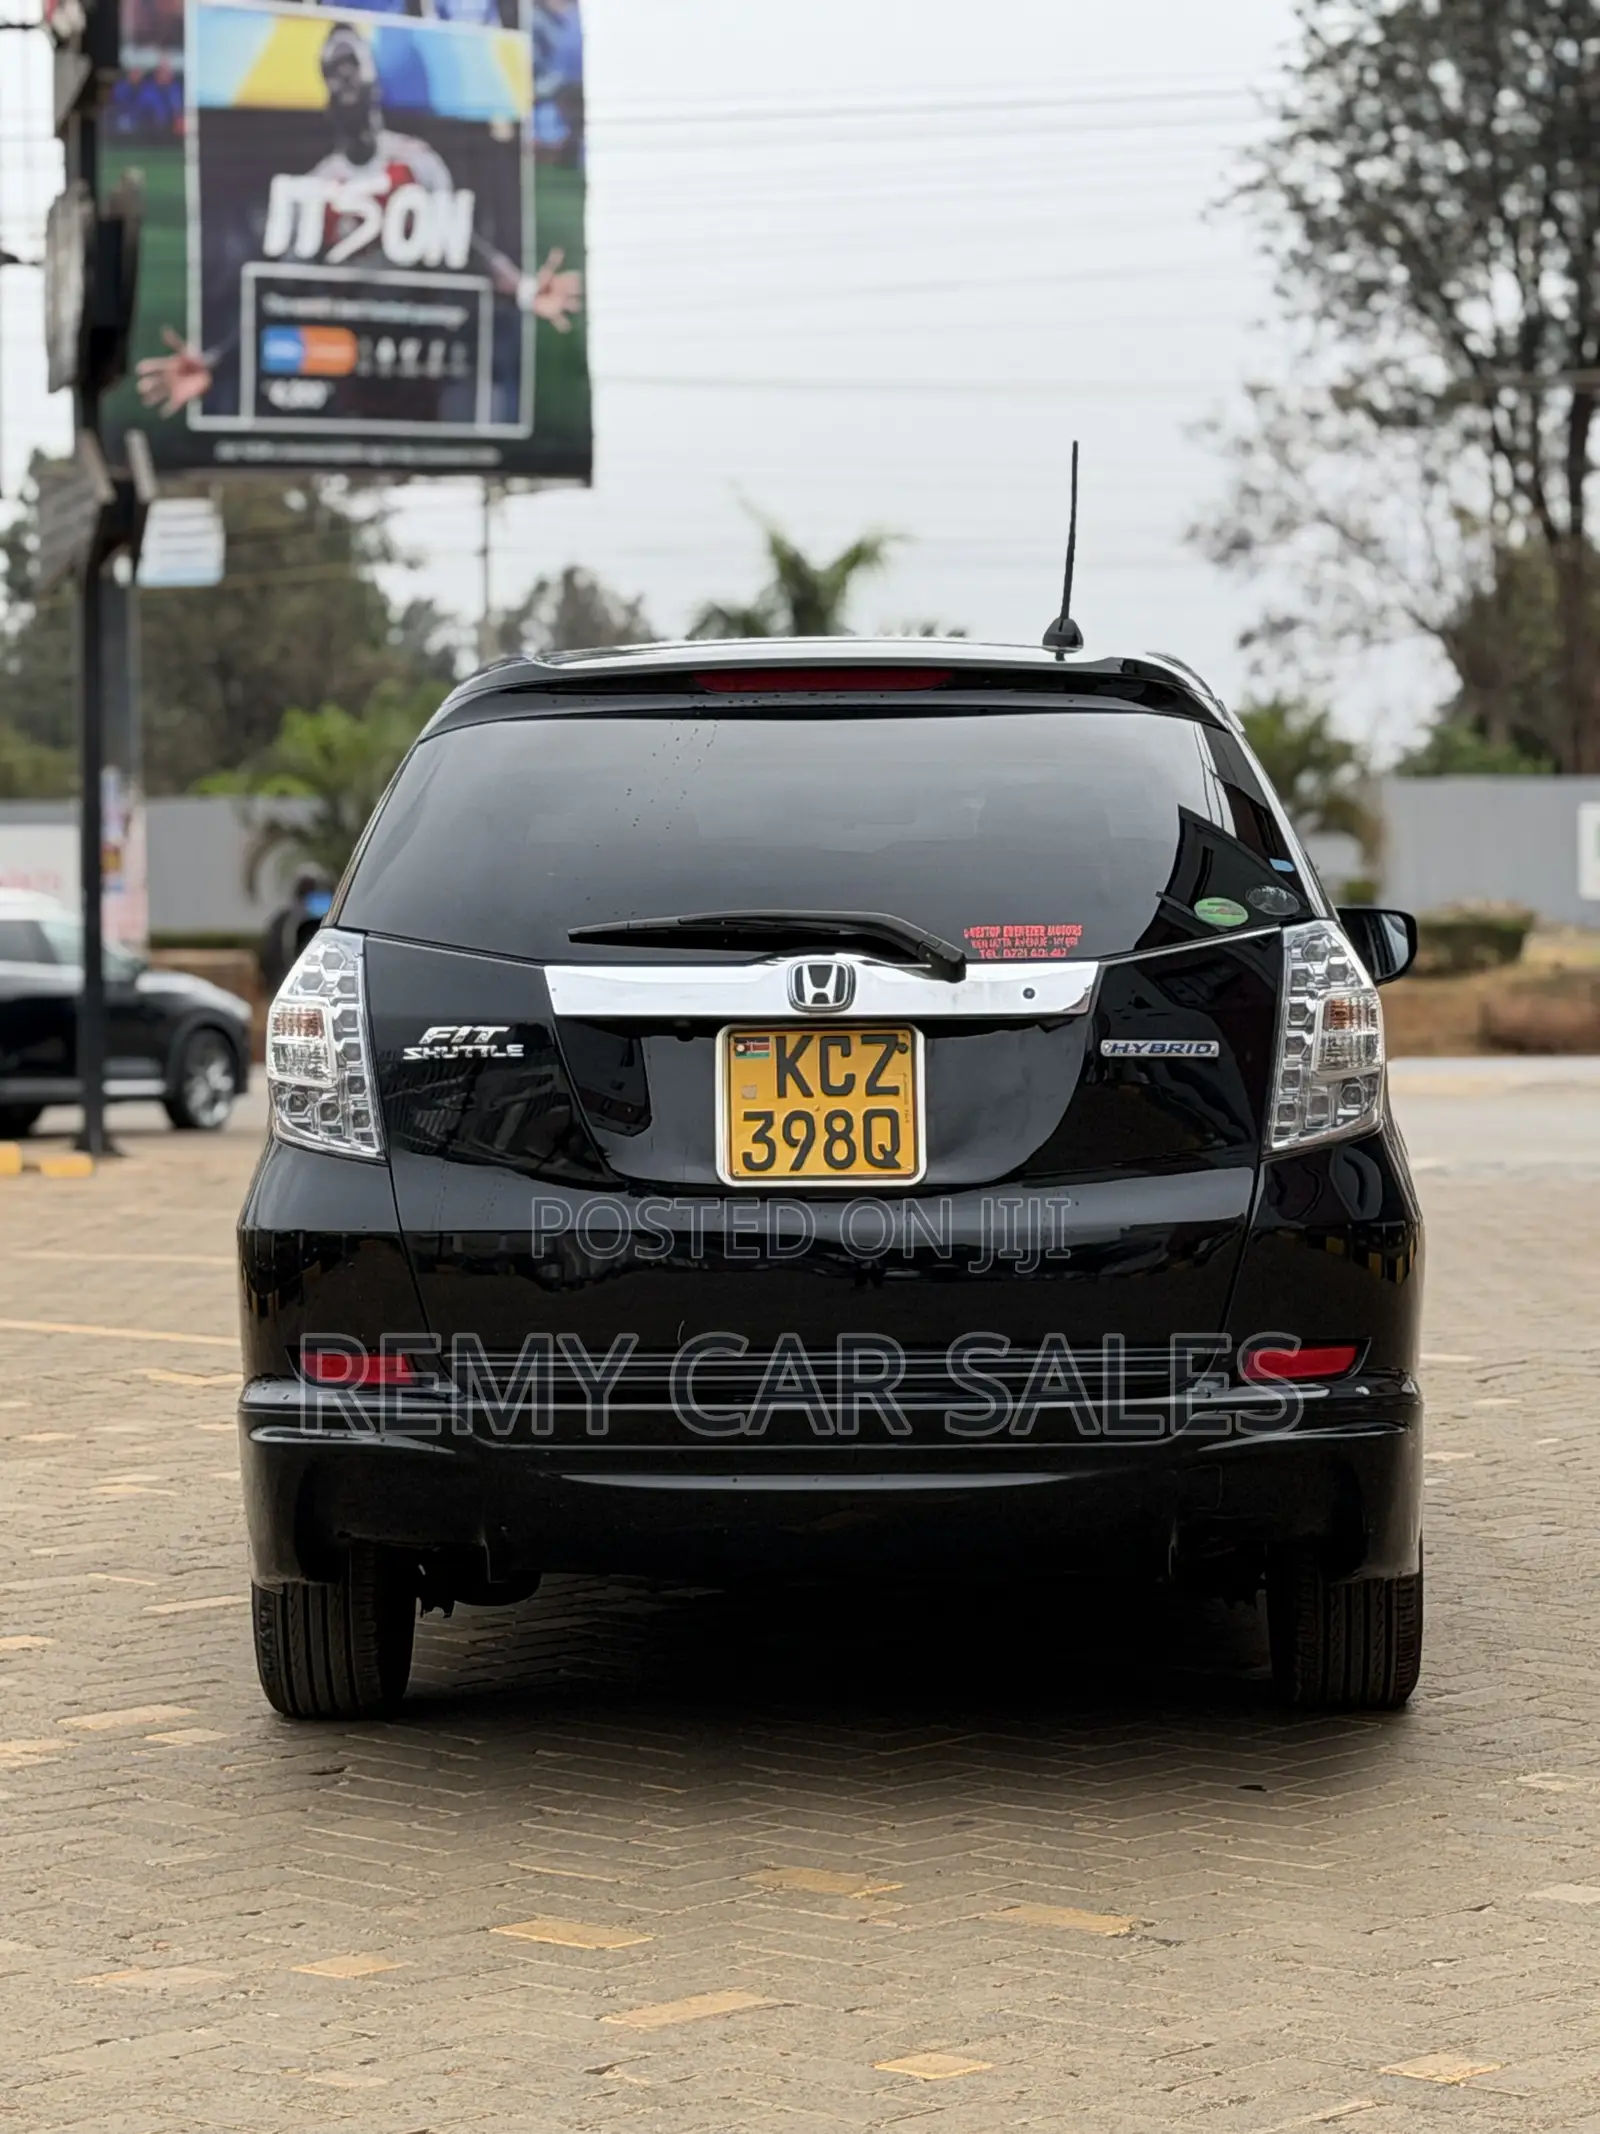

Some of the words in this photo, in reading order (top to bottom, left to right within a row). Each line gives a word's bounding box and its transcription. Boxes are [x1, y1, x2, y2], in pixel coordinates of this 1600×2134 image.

[418, 1026, 510, 1045] FIT
[402, 1044, 524, 1060] SHUTTLE
[1110, 1042, 1212, 1055] HYBRID
[775, 1034, 900, 1098] KCZ
[742, 1108, 902, 1172] 398Q
